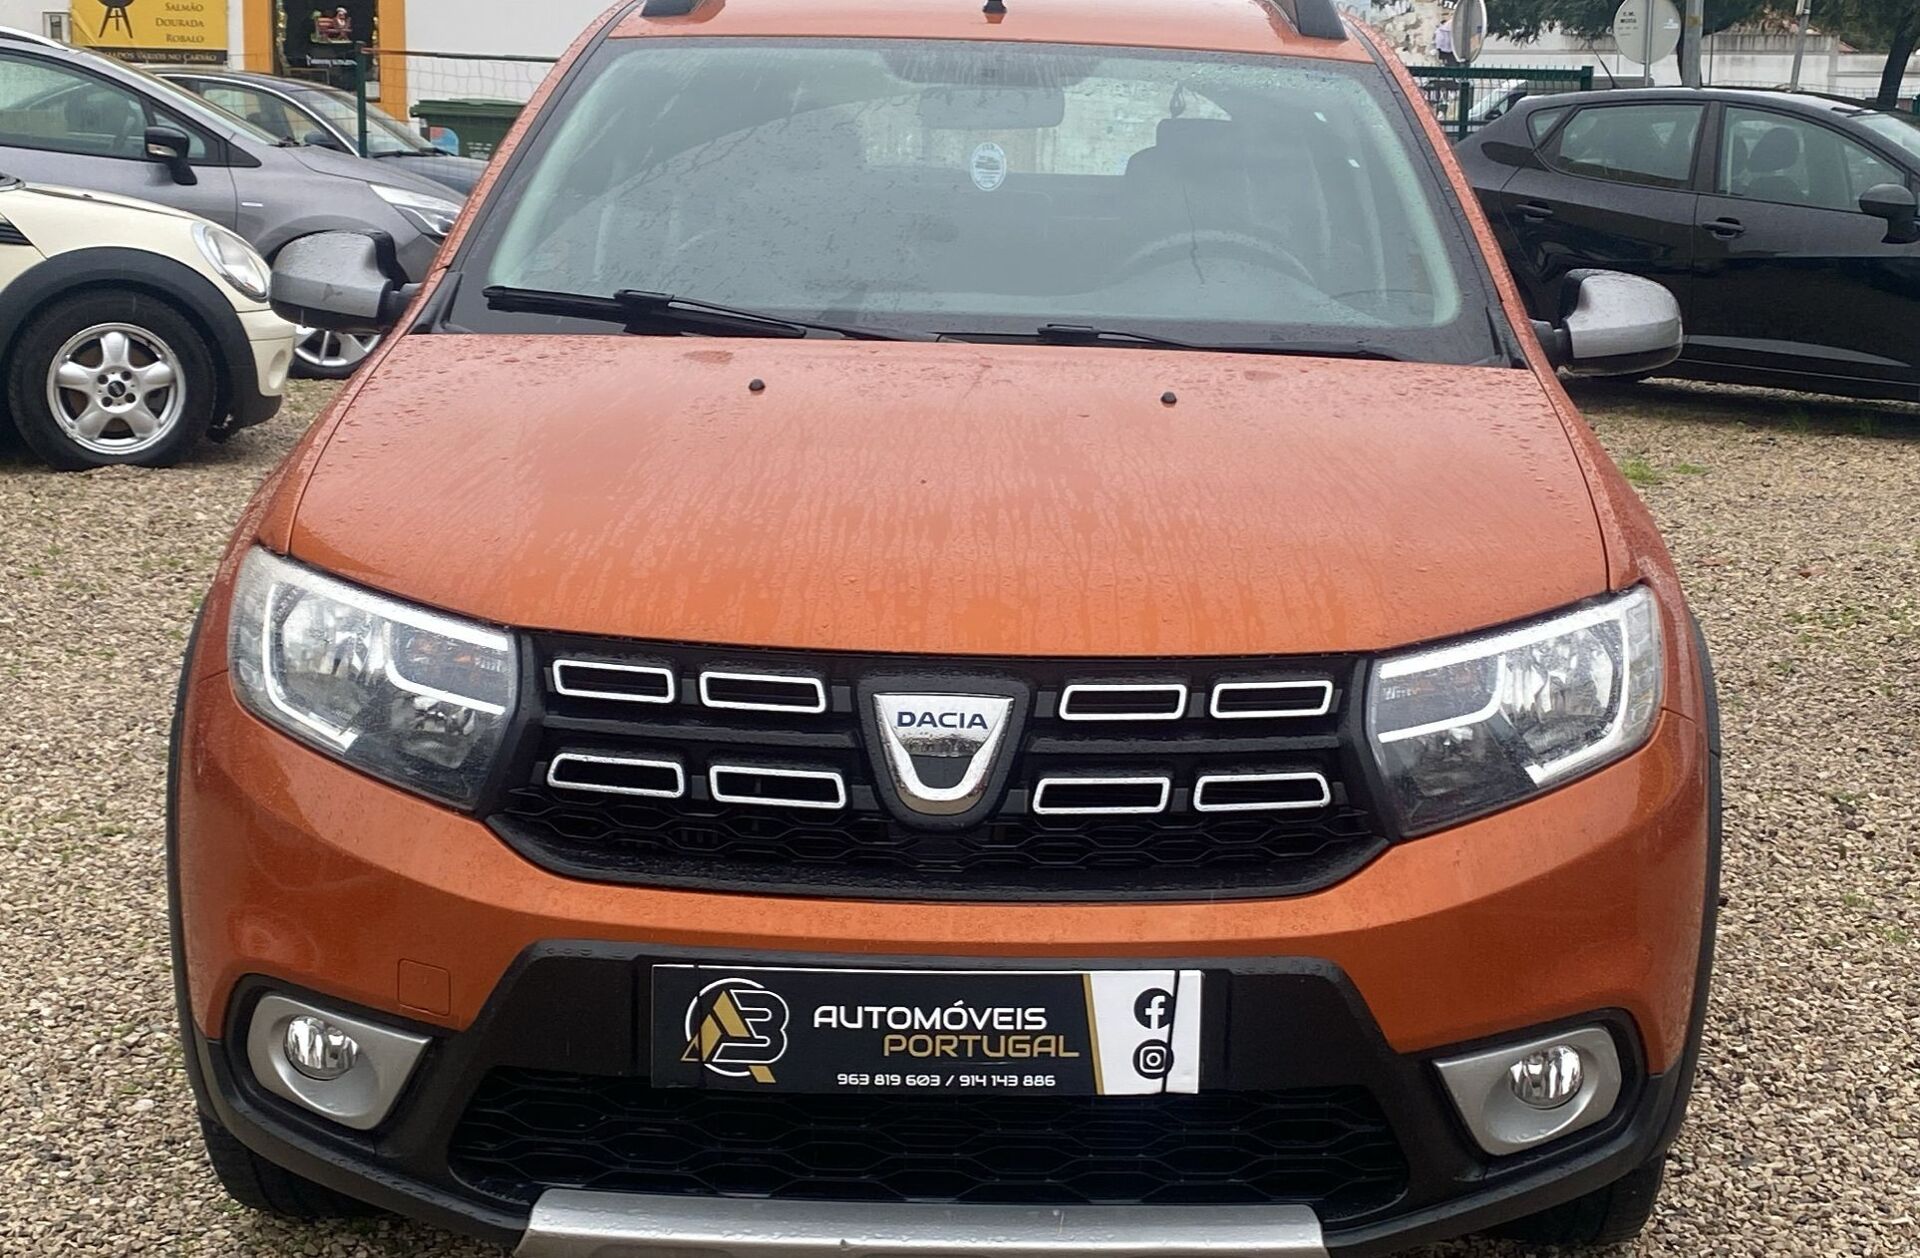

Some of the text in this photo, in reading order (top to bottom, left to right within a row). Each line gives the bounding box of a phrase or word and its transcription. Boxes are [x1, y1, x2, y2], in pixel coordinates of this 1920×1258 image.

[155, 17, 205, 28] DOURADA
[166, 34, 205, 43] ROBALO
[896, 711, 989, 730] DACIA
[813, 1000, 1048, 1031] AUTOMÓVEIS
[882, 1034, 1080, 1058] PORTUGAL
[837, 1073, 870, 1086] 963
[874, 1074, 901, 1086] 819
[905, 1074, 941, 1087] 603
[959, 1075, 988, 1087] 914
[991, 1075, 1019, 1087] 143
[1022, 1075, 1056, 1087] 886
